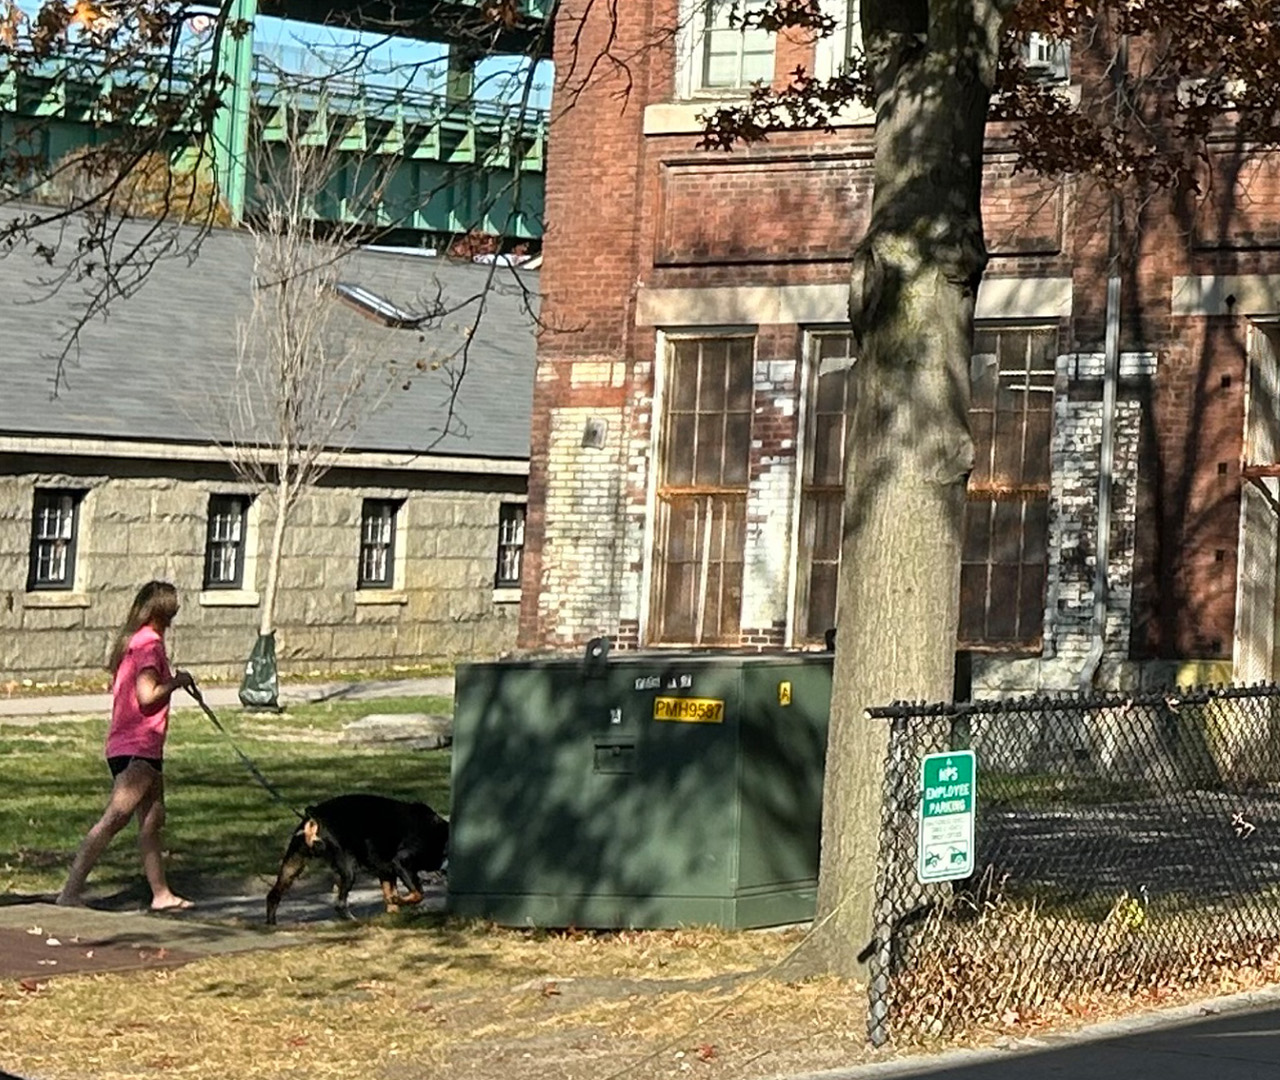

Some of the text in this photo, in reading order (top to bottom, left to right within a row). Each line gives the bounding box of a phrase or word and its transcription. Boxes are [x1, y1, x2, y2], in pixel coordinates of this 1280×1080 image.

[781, 688, 789, 701] A
[655, 701, 722, 719] PMH9587
[939, 767, 958, 782] NPS
[925, 783, 970, 800] EMPLOYEE
[929, 799, 966, 815] PARKING
